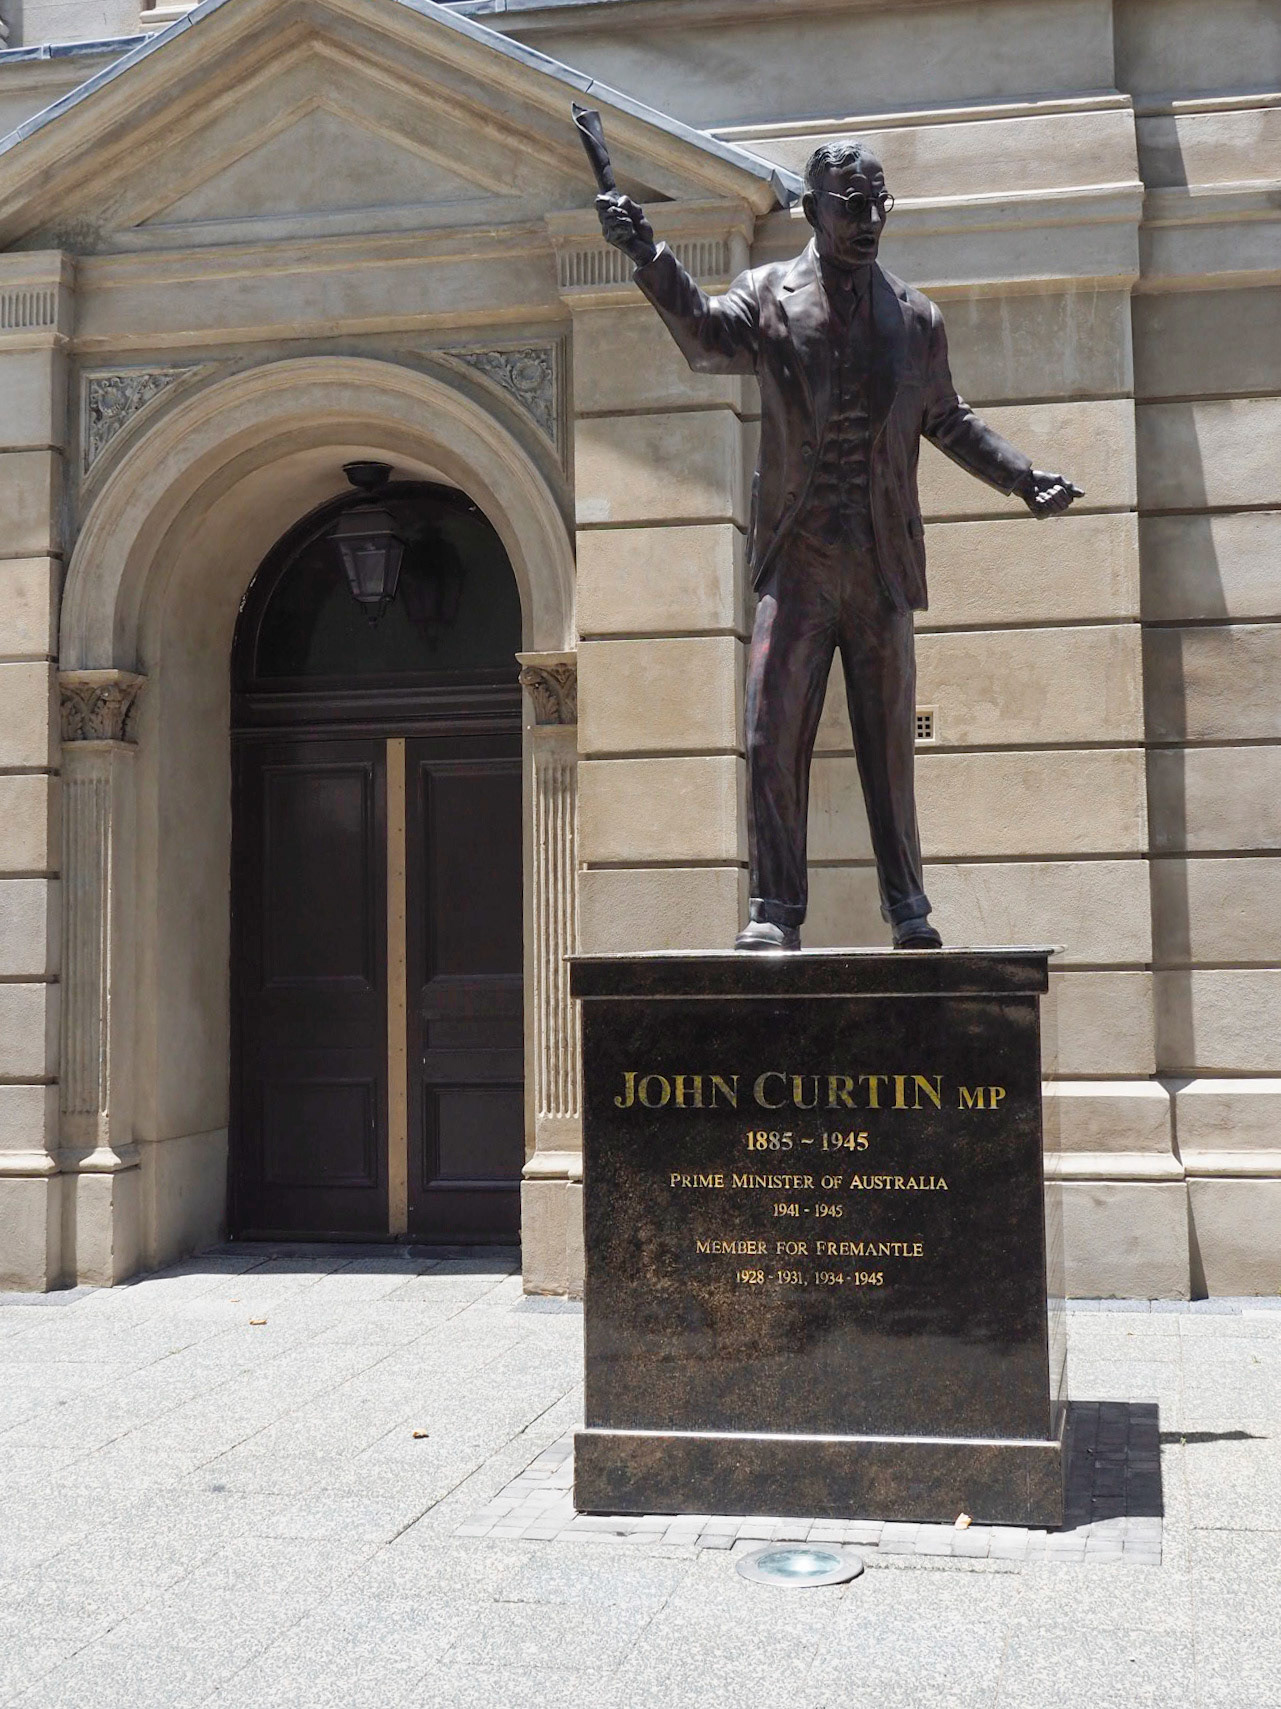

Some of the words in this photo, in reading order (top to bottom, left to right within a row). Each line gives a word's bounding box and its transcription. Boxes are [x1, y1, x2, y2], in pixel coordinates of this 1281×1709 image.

[614, 1071, 740, 1109] JOHN
[754, 1071, 943, 1109] CURTIN
[957, 1086, 1007, 1109] MP
[746, 1131, 793, 1151] 1885
[822, 1132, 869, 1151] 1945
[670, 1173, 724, 1188] PRIME
[732, 1174, 814, 1189] MINISTER
[821, 1175, 842, 1189] OF
[850, 1175, 948, 1190] AUSTRALIA
[773, 1204, 800, 1217] 1941
[815, 1204, 843, 1217] 1945
[696, 1240, 767, 1255] MEMBER
[776, 1241, 808, 1255] FOR
[816, 1241, 923, 1256] FREMANTLE
[736, 1271, 764, 1284] 1928
[777, 1271, 808, 1286] 1931,
[815, 1272, 844, 1285] 1934
[855, 1272, 883, 1286] 1945
